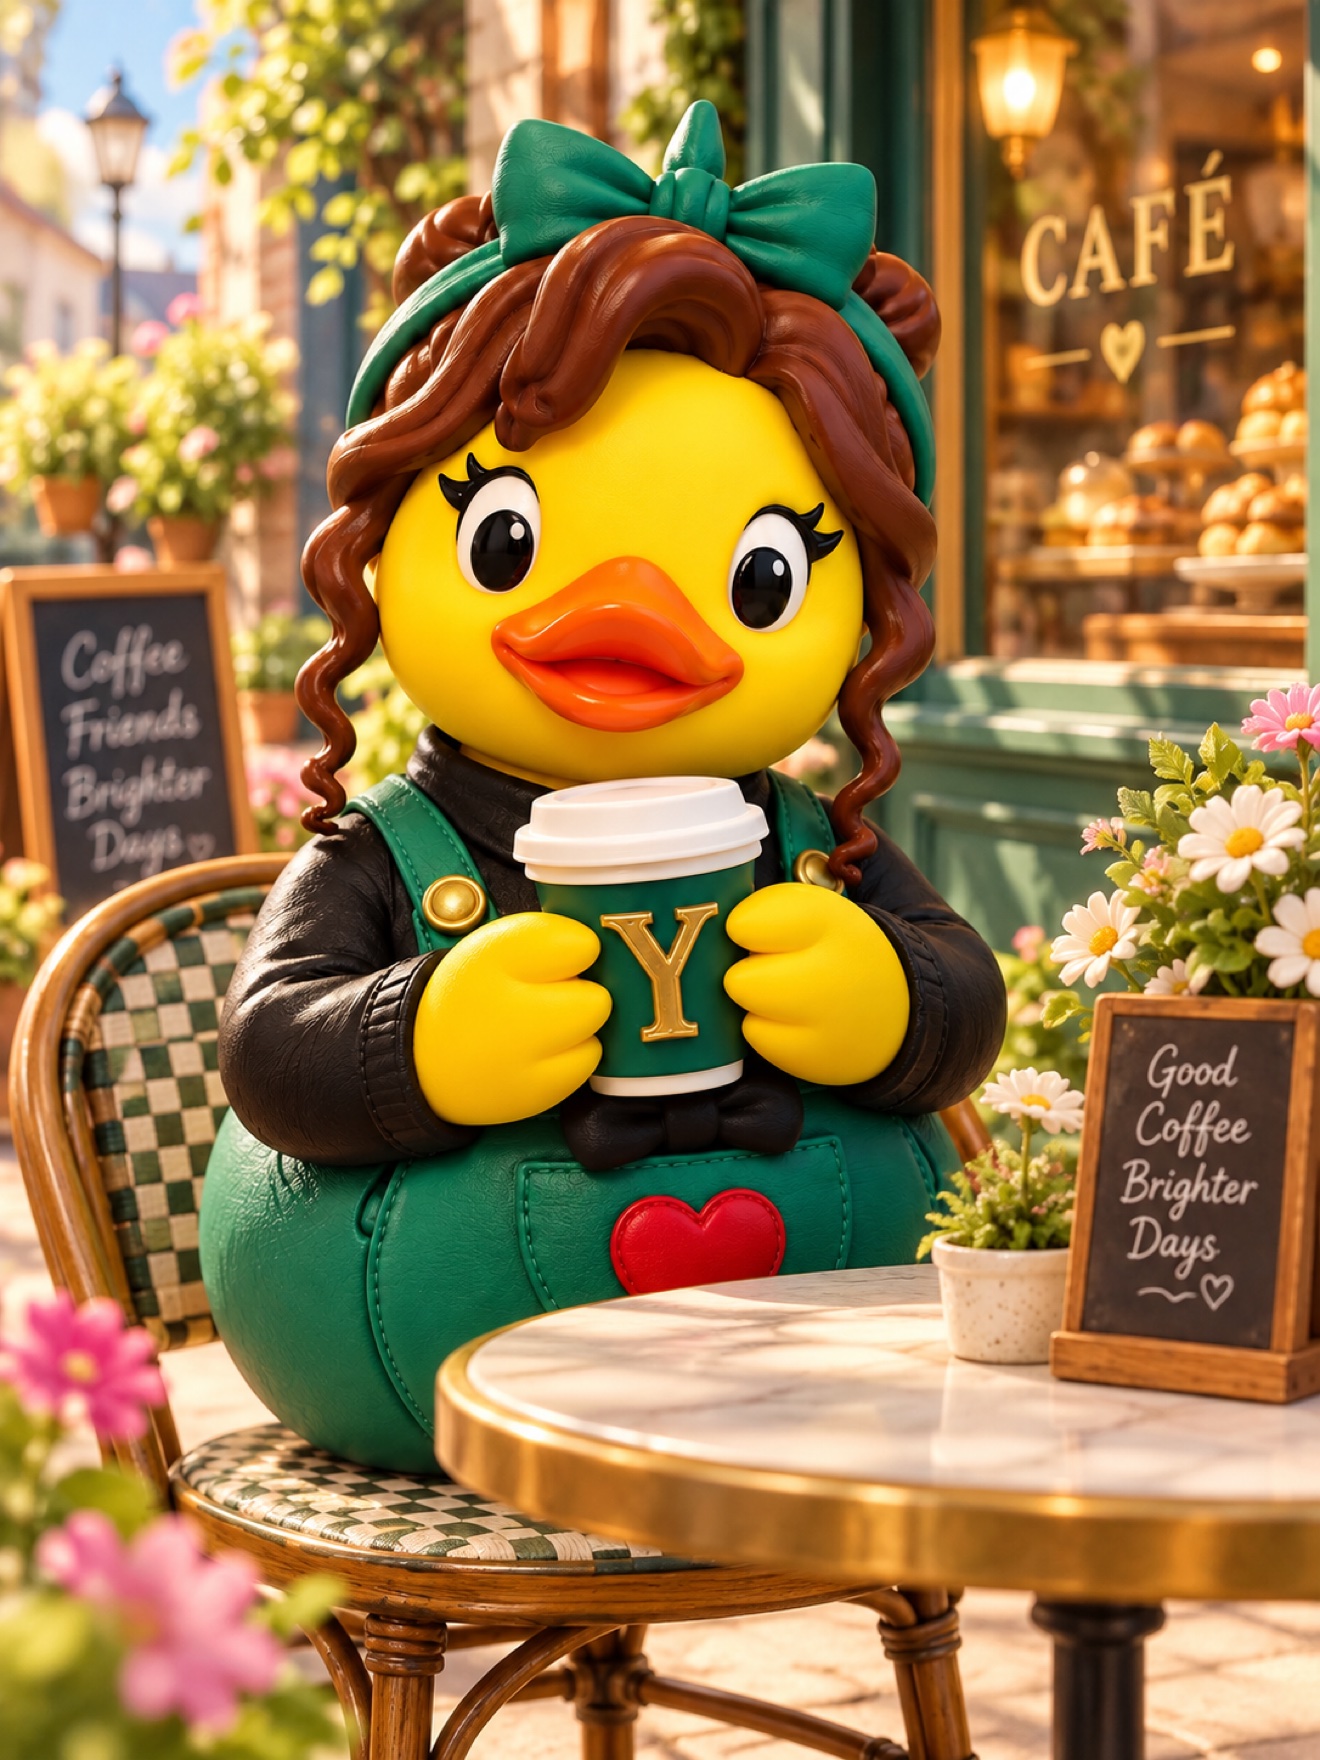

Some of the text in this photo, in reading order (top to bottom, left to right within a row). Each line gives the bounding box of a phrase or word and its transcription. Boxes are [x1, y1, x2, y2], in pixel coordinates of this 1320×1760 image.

[1020, 149, 1235, 306] CAFÉ
[61, 624, 188, 698] Coffee
[61, 688, 201, 760] Friends
[62, 755, 212, 827] Brighter
[87, 819, 183, 878] Days
[600, 902, 719, 1042] Y
[1147, 1043, 1239, 1098] Good
[1136, 1100, 1251, 1158] Coffee
[1120, 1158, 1258, 1221] Brighter
[1127, 1216, 1220, 1280] Days
